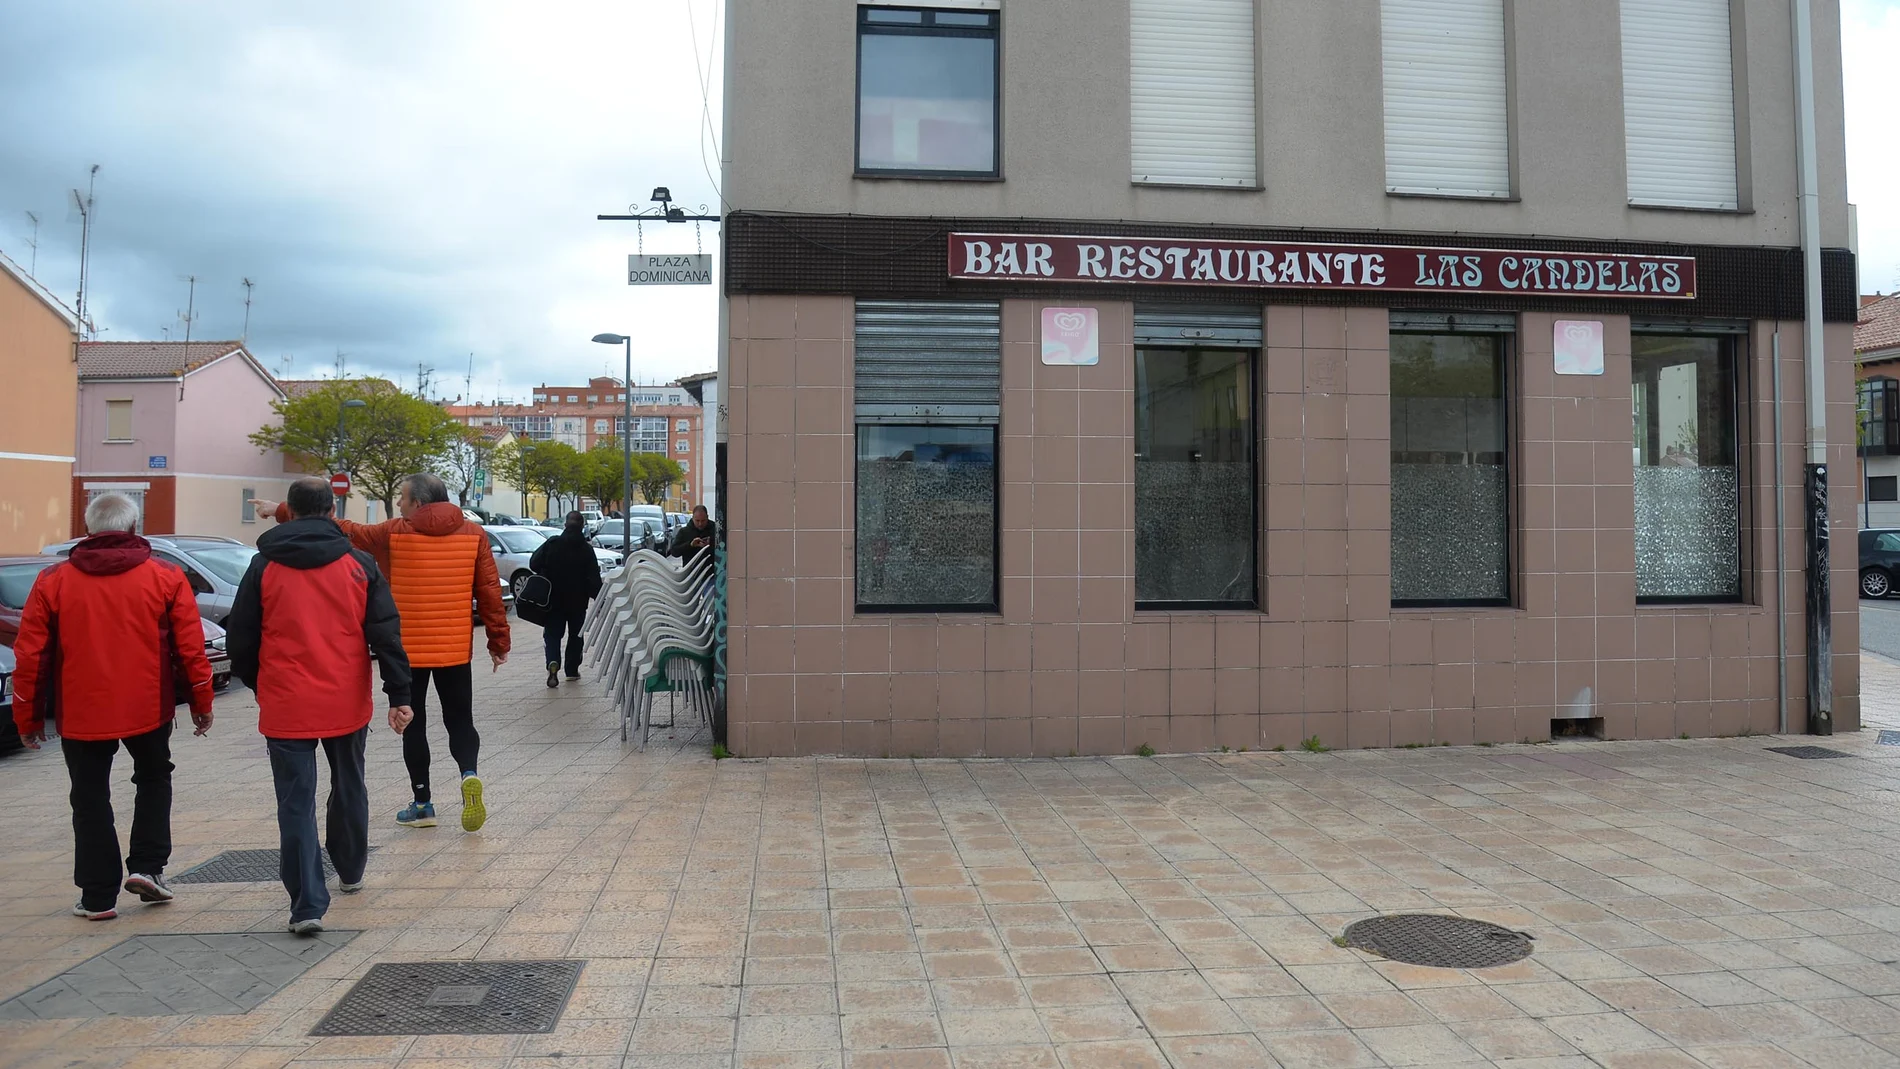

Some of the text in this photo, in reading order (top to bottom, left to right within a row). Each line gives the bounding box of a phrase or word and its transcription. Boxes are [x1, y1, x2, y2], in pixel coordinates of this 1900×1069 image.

[649, 257, 691, 267] PLAZA
[963, 241, 1681, 293] BAR RESTAURANTE LAS CANDELAS
[630, 270, 710, 282] DOMINICANA
